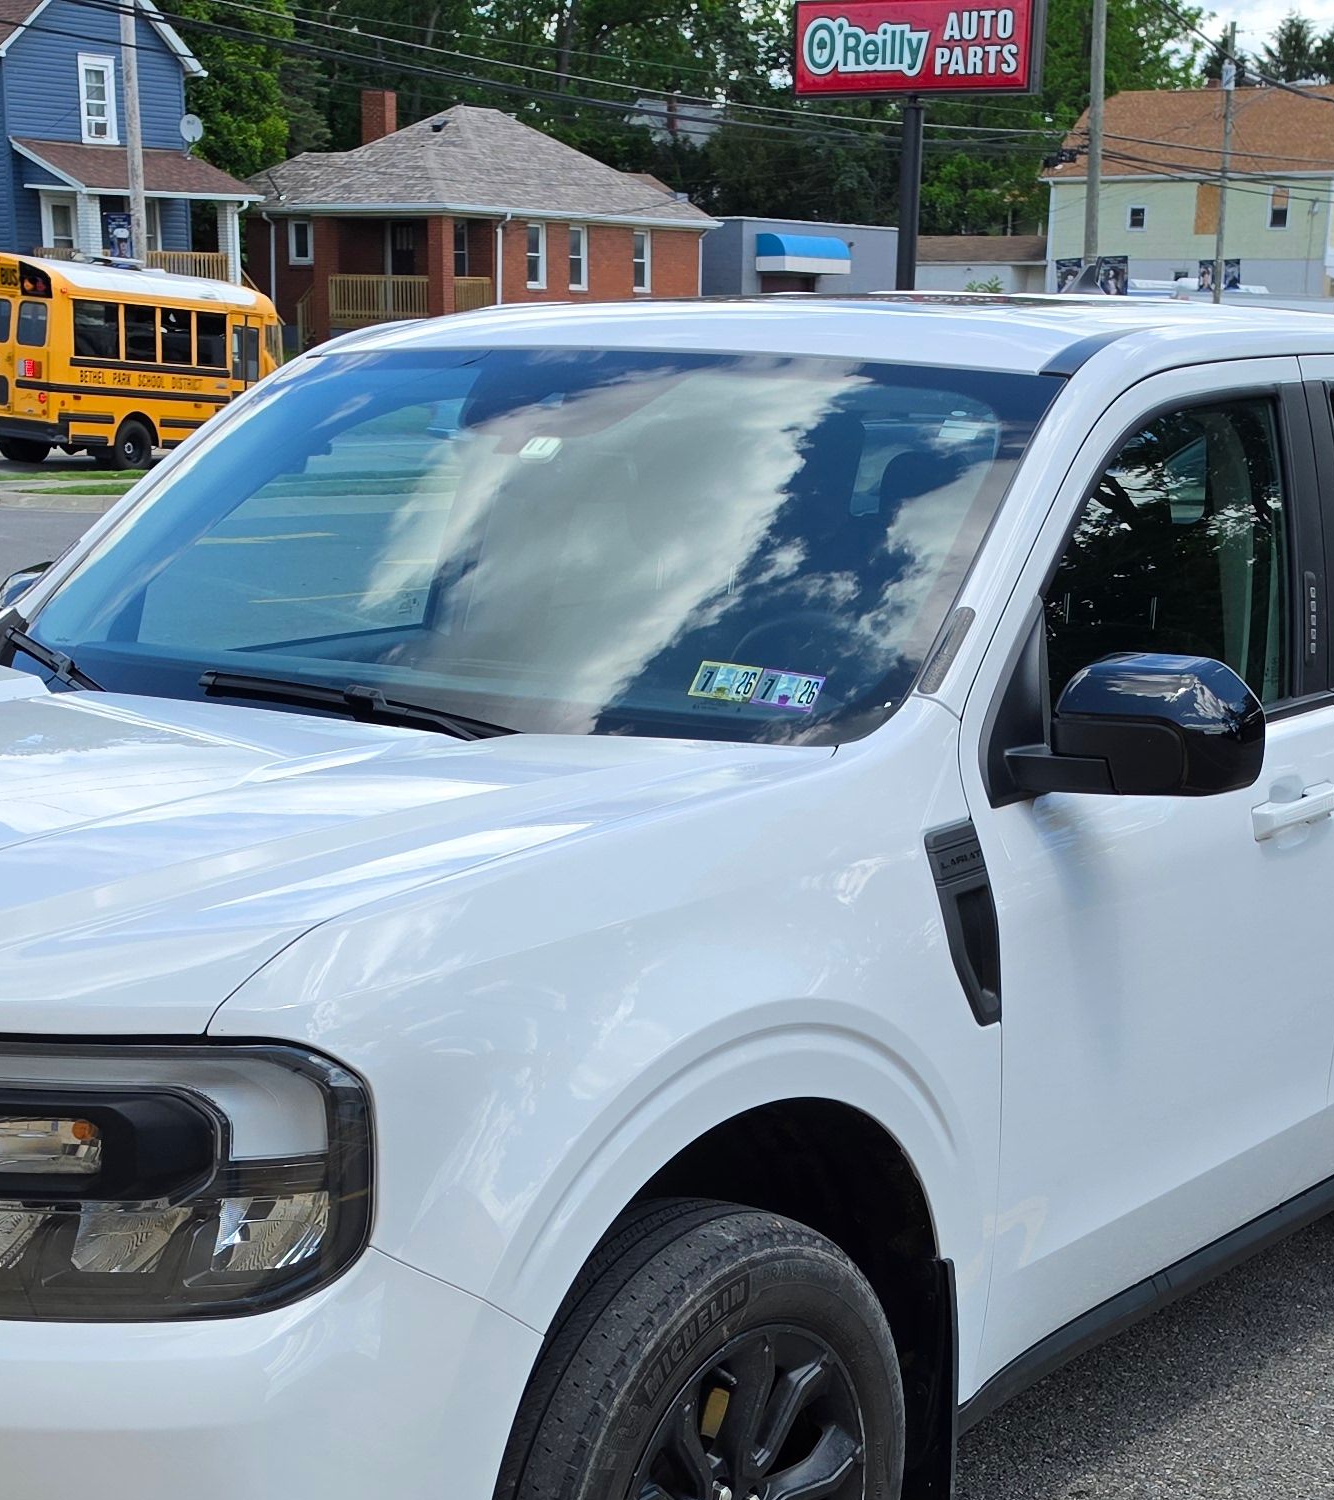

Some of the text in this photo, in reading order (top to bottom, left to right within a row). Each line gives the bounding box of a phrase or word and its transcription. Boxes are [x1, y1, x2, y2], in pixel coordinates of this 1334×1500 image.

[943, 9, 1014, 41] AUTO
[806, 21, 925, 72] O'Reilly
[934, 44, 1018, 76] PARTS
[0, 267, 19, 287] BUS
[79, 369, 204, 391] BETHEL PARK SCHOOL DISTRICT
[700, 671, 757, 695] 7 26
[760, 678, 820, 705] 7 26
[939, 850, 982, 870] LARIAT
[643, 1280, 747, 1401] MICHELIN
